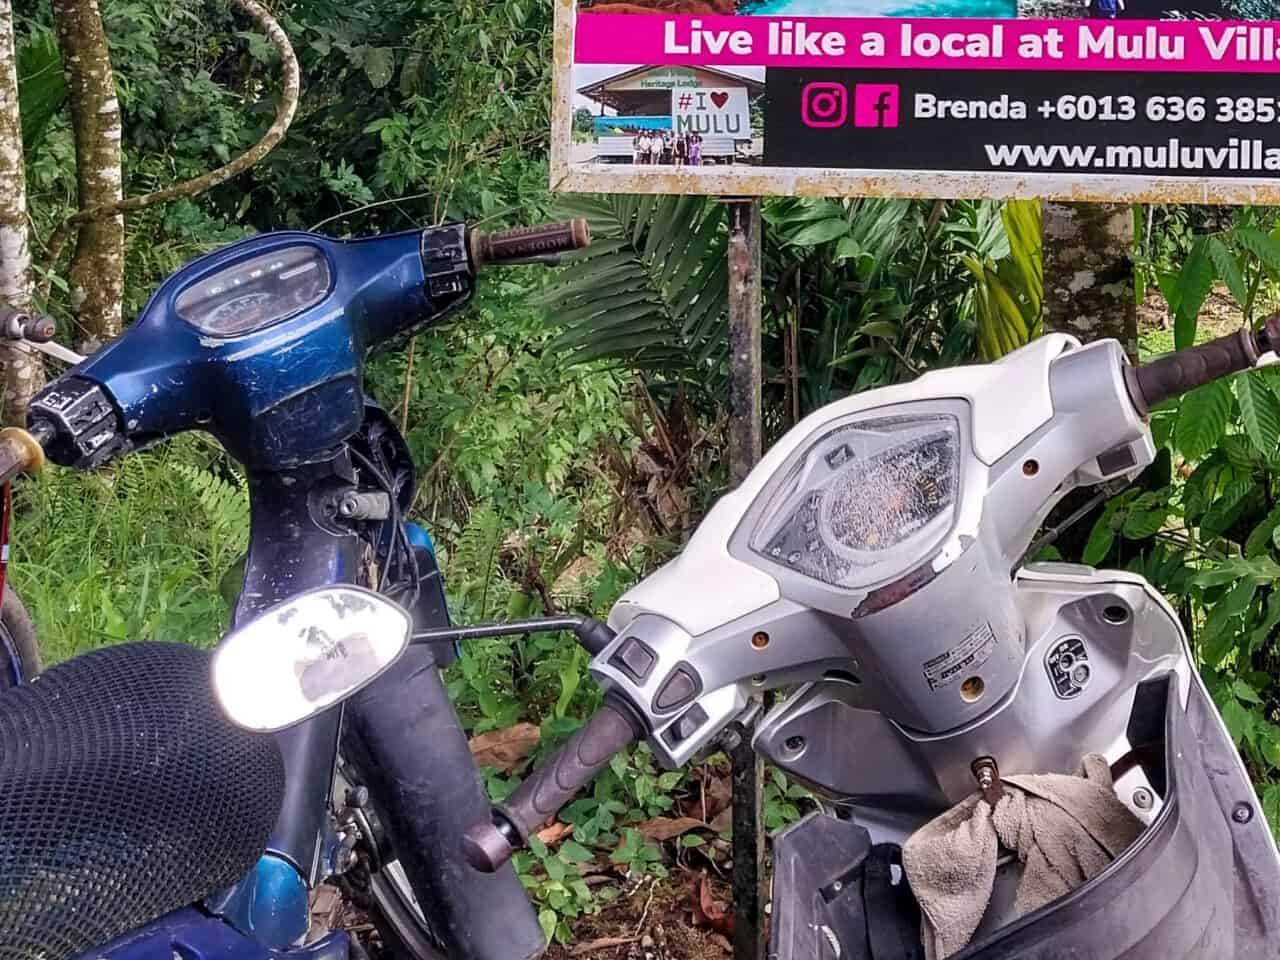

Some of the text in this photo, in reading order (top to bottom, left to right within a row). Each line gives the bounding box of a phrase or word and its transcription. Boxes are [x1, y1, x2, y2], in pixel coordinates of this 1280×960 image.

[664, 19, 753, 55] Live
[767, 20, 847, 57] like
[859, 30, 886, 57] a
[900, 23, 1004, 58] local
[1017, 29, 1063, 59] at
[1078, 25, 1185, 61] Mulu
[914, 93, 1027, 119] Brenda
[1037, 94, 1136, 121] +6013
[1145, 95, 1206, 122] 636
[677, 114, 740, 134] MULU
